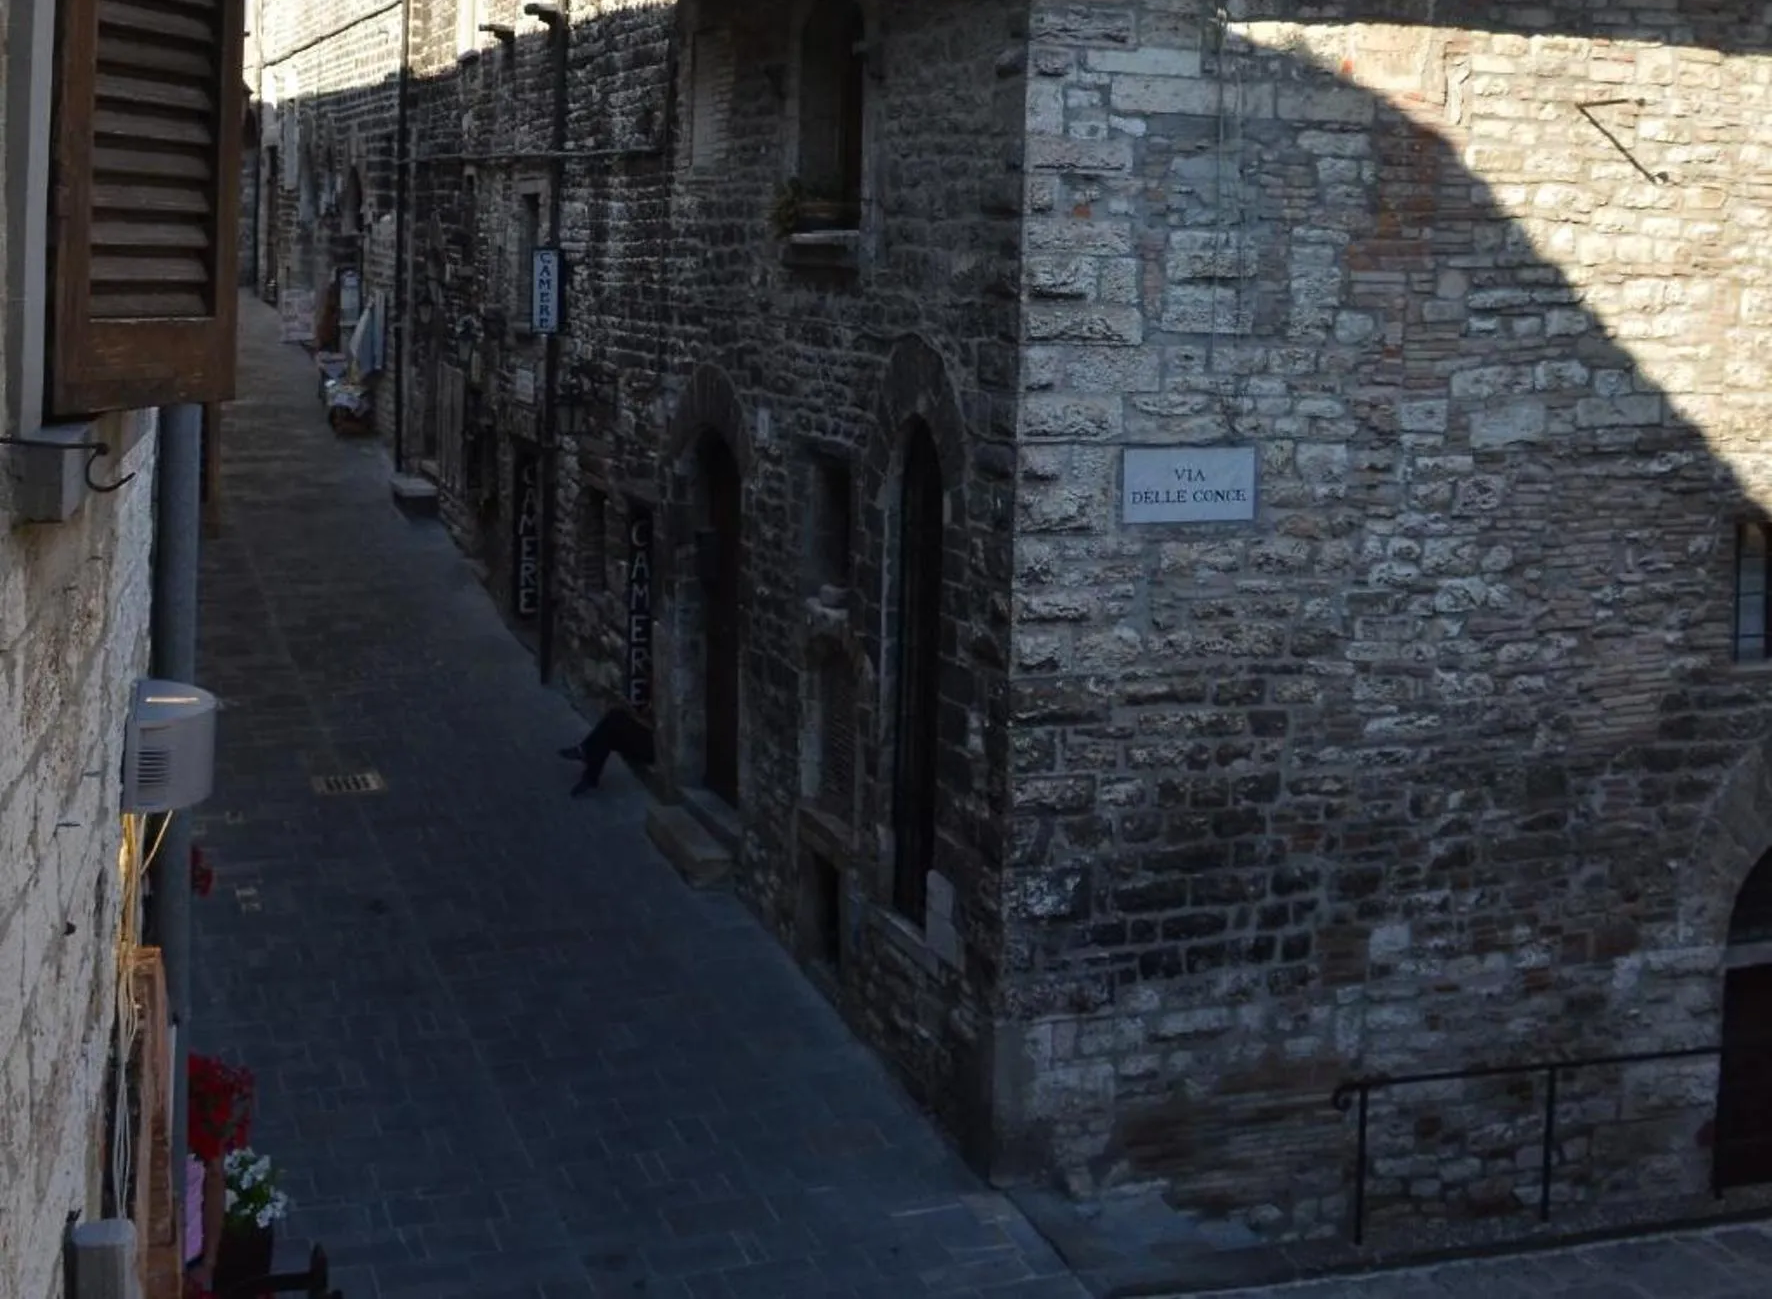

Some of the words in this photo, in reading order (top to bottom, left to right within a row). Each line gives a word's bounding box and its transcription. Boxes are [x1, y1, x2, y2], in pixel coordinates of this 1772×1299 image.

[537, 252, 552, 329] CAMERE
[1131, 489, 1188, 505] DELLE
[1192, 489, 1248, 503] CONCE
[1174, 468, 1206, 482] VIA
[518, 461, 538, 614] CAMERE
[629, 519, 651, 706] CAMERE
